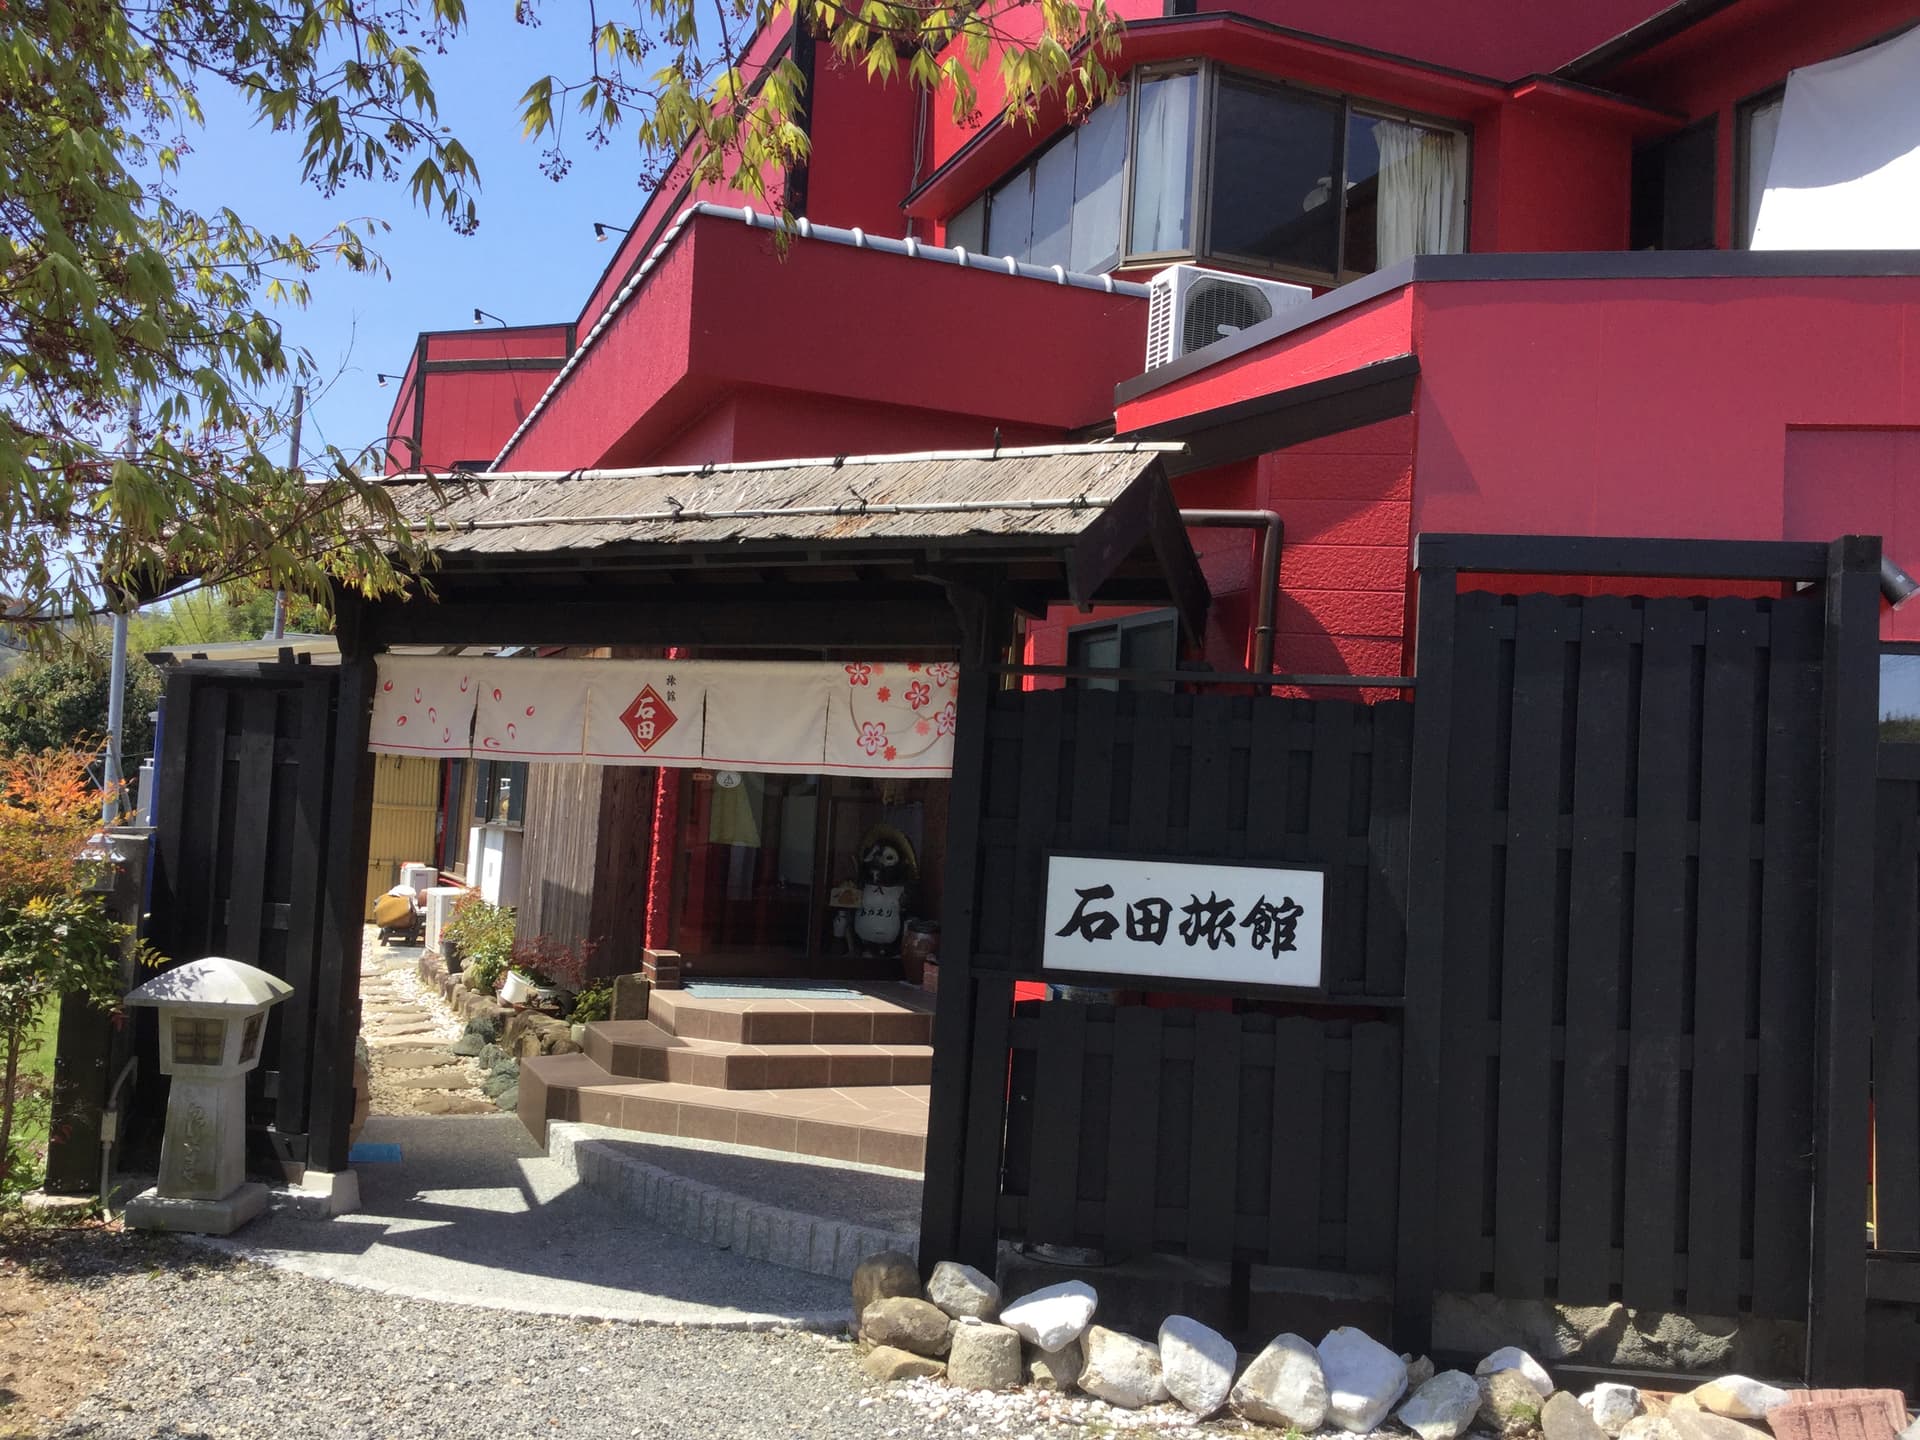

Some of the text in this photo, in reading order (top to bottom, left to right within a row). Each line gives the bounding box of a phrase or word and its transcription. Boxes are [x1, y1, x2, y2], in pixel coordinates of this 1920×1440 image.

[634, 696, 656, 740] 石田
[1055, 884, 1304, 960] 石田旅館
